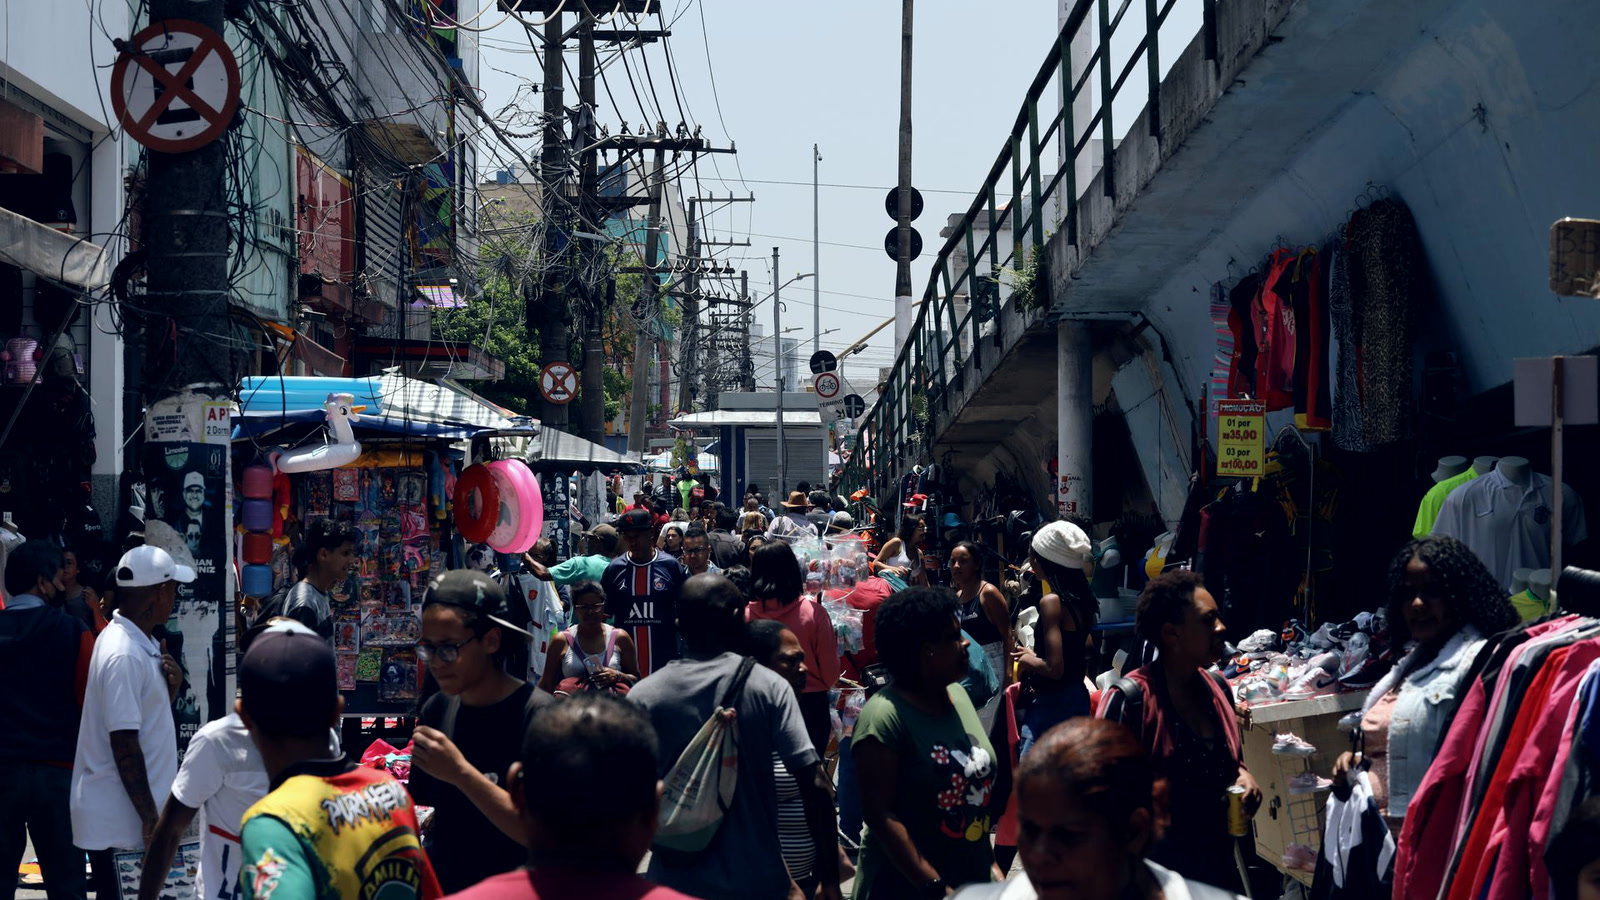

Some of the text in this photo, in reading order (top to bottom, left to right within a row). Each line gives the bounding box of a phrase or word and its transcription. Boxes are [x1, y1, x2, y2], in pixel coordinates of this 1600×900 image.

[1227, 418, 1251, 428] 01 por
[1226, 447, 1251, 458] 03 por
